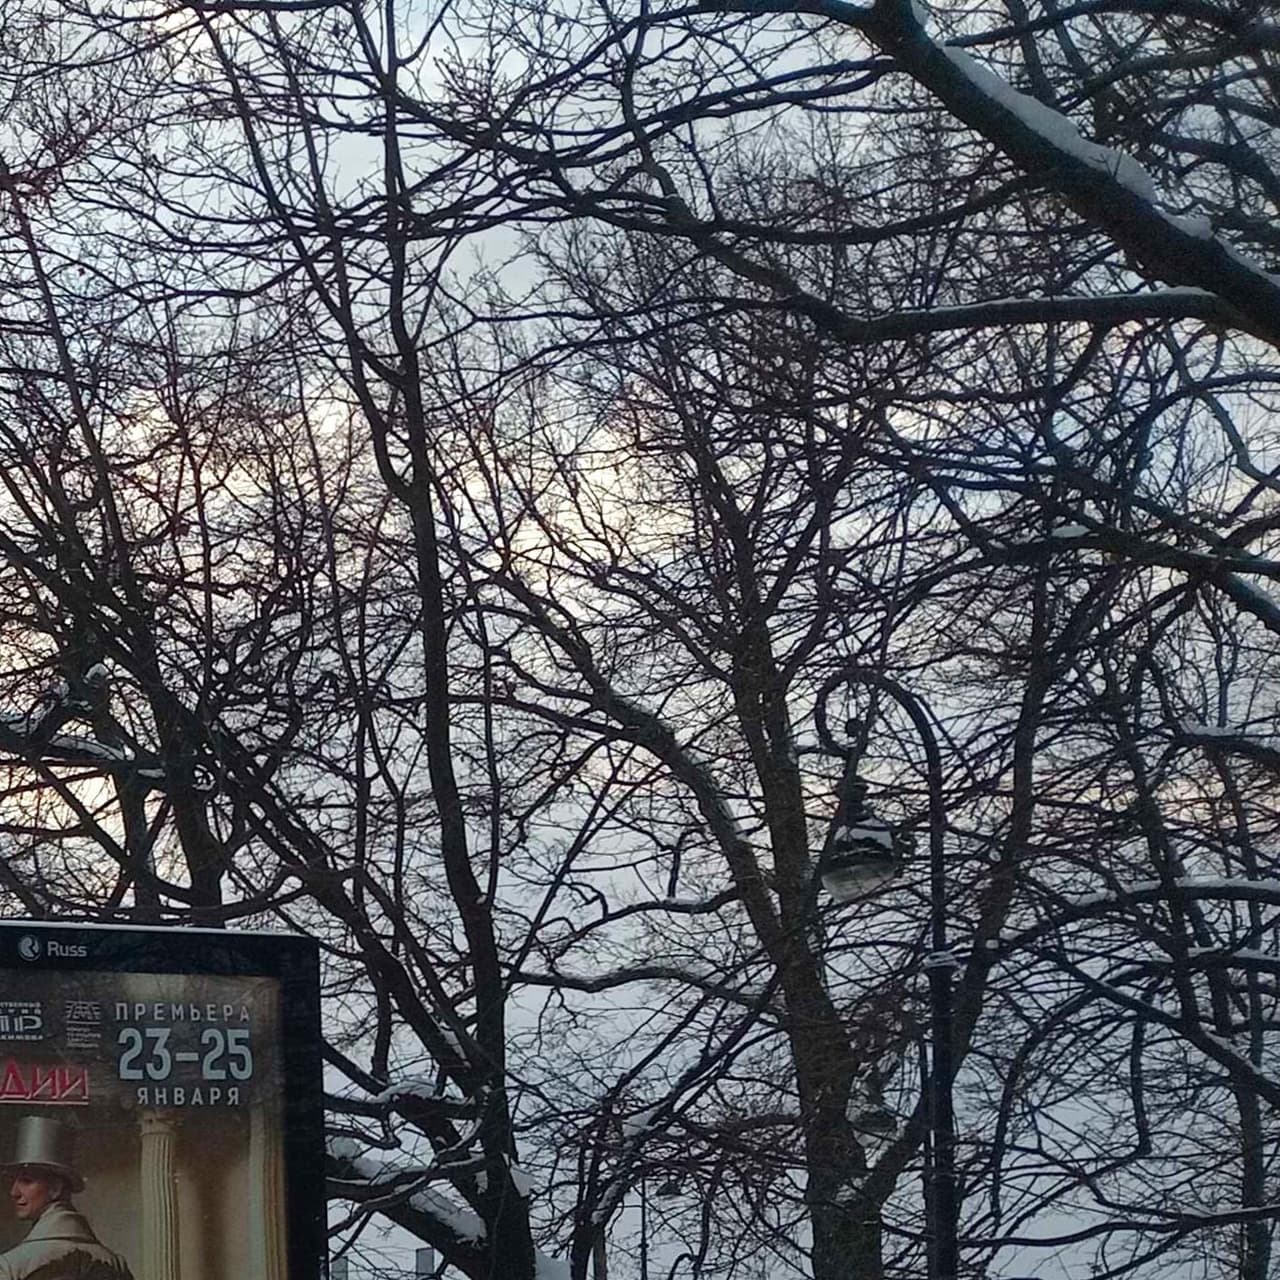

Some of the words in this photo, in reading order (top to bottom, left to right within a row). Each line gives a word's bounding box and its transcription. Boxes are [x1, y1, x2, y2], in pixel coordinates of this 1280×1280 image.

[47, 941, 87, 957] Russ
[116, 1002, 251, 1022] ПРЕМЬЕРА
[137, 1087, 240, 1106] ЯНВАРЯ
